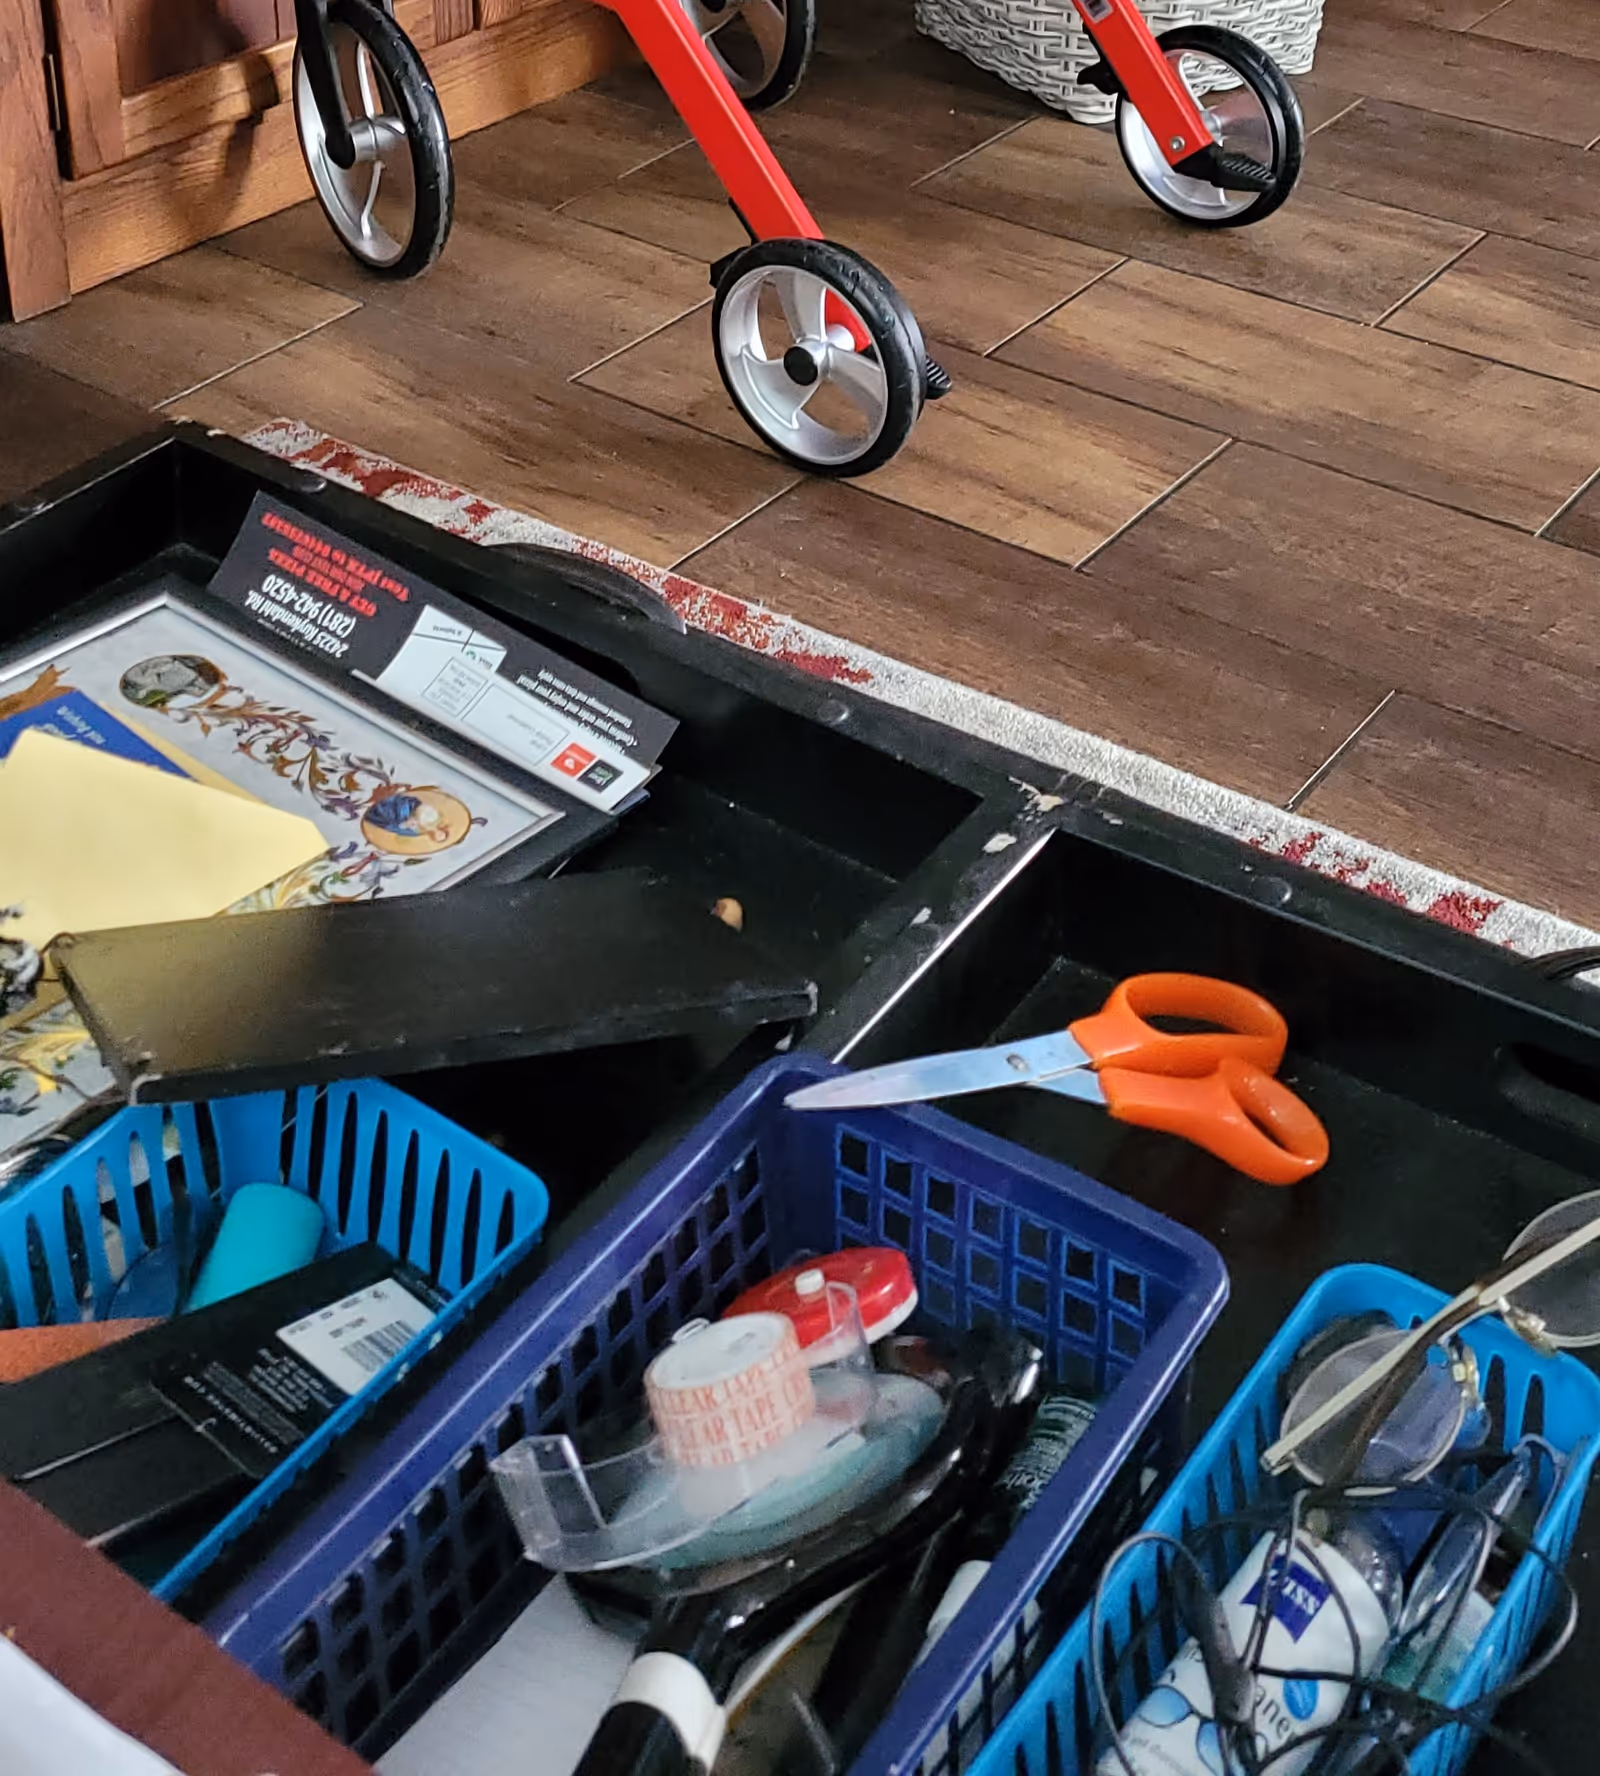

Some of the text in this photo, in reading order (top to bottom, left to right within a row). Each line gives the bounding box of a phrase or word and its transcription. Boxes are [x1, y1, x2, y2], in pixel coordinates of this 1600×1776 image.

[245, 590, 265, 611] Rd.
[262, 574, 323, 617] 942-4520
[259, 599, 320, 642] Kuykendahl
[318, 604, 356, 638] (281)
[313, 631, 349, 658] 24225
[728, 1390, 778, 1438] TAPE
